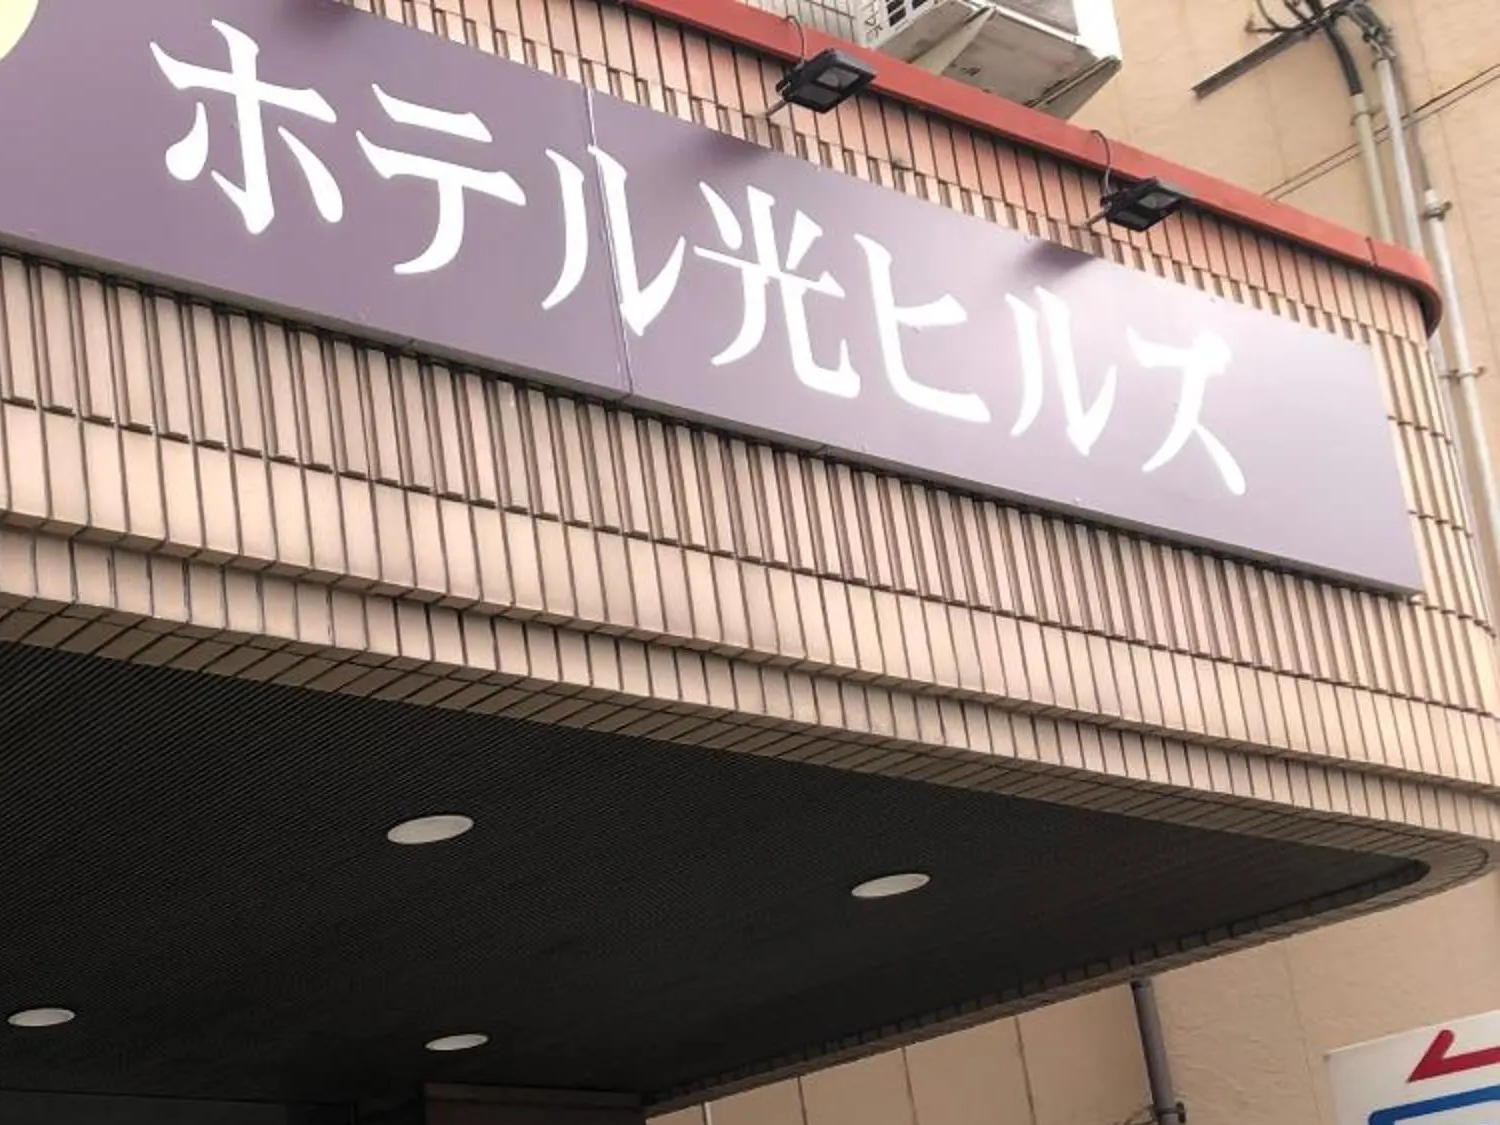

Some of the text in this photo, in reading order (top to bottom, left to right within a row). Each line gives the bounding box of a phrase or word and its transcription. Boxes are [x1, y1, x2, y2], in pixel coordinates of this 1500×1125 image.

[149, 17, 1248, 498] ホテル光ヒルズ
